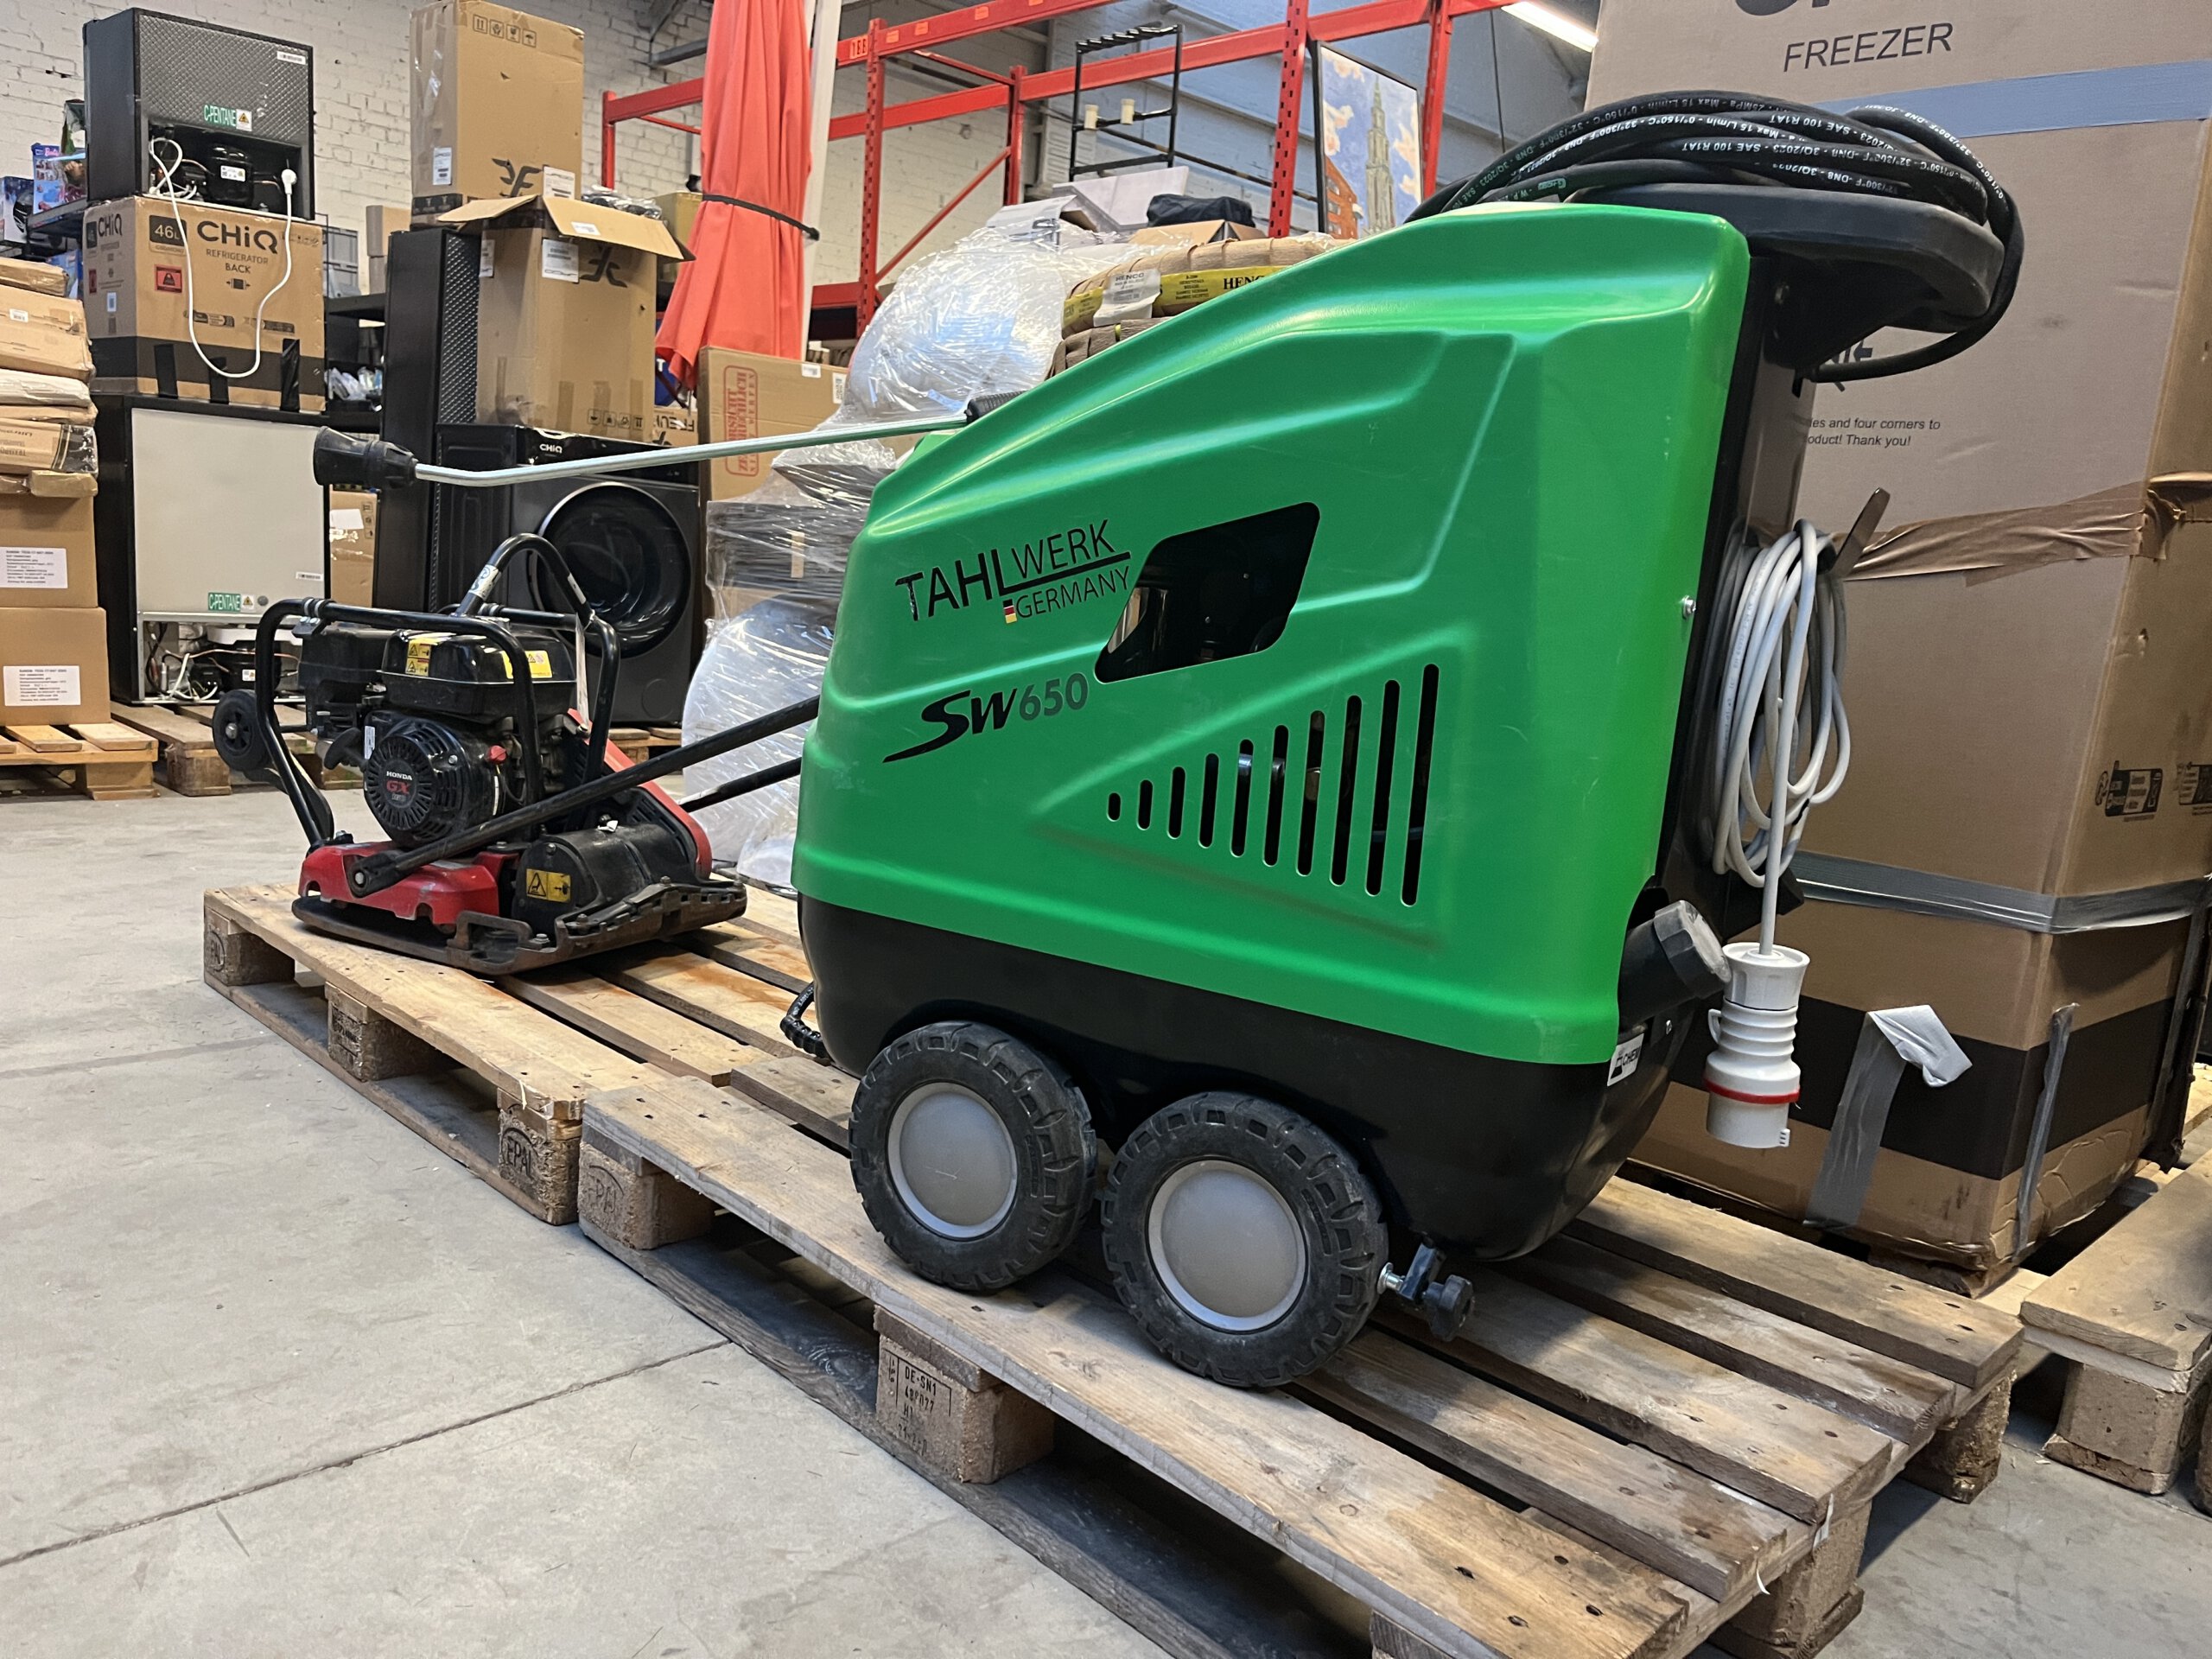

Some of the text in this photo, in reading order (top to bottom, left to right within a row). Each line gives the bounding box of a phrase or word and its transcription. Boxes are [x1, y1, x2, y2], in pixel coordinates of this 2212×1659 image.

[1783, 22, 1954, 73] FREEZER
[1707, 118, 1738, 130] L/min
[1769, 114, 1800, 126] R1AT
[1802, 118, 1823, 129] 100
[1740, 123, 1753, 133] 15
[1757, 124, 1780, 140] Max
[1827, 121, 1853, 136] SAE
[1681, 142, 1711, 152] R1AT
[1713, 143, 1732, 152] 100
[1737, 143, 1761, 153] SAE
[1772, 143, 1821, 157] 3Q/2023
[206, 248, 269, 265] REFRIGERATOR
[225, 263, 251, 275] BACK
[1116, 272, 1145, 283] HENCO
[1828, 417, 1851, 429] and
[1854, 417, 1878, 429] four
[1880, 419, 1925, 430] corners
[1929, 419, 1941, 430] to
[1847, 434, 1882, 446] Thank
[1885, 435, 1911, 448] you!
[895, 519, 1131, 622] TAHLWERK
[1015, 566, 1130, 619] GERMANY
[209, 594, 241, 611] C-PENTANE
[386, 771, 413, 781] HONDA
[386, 779, 411, 795] GX
